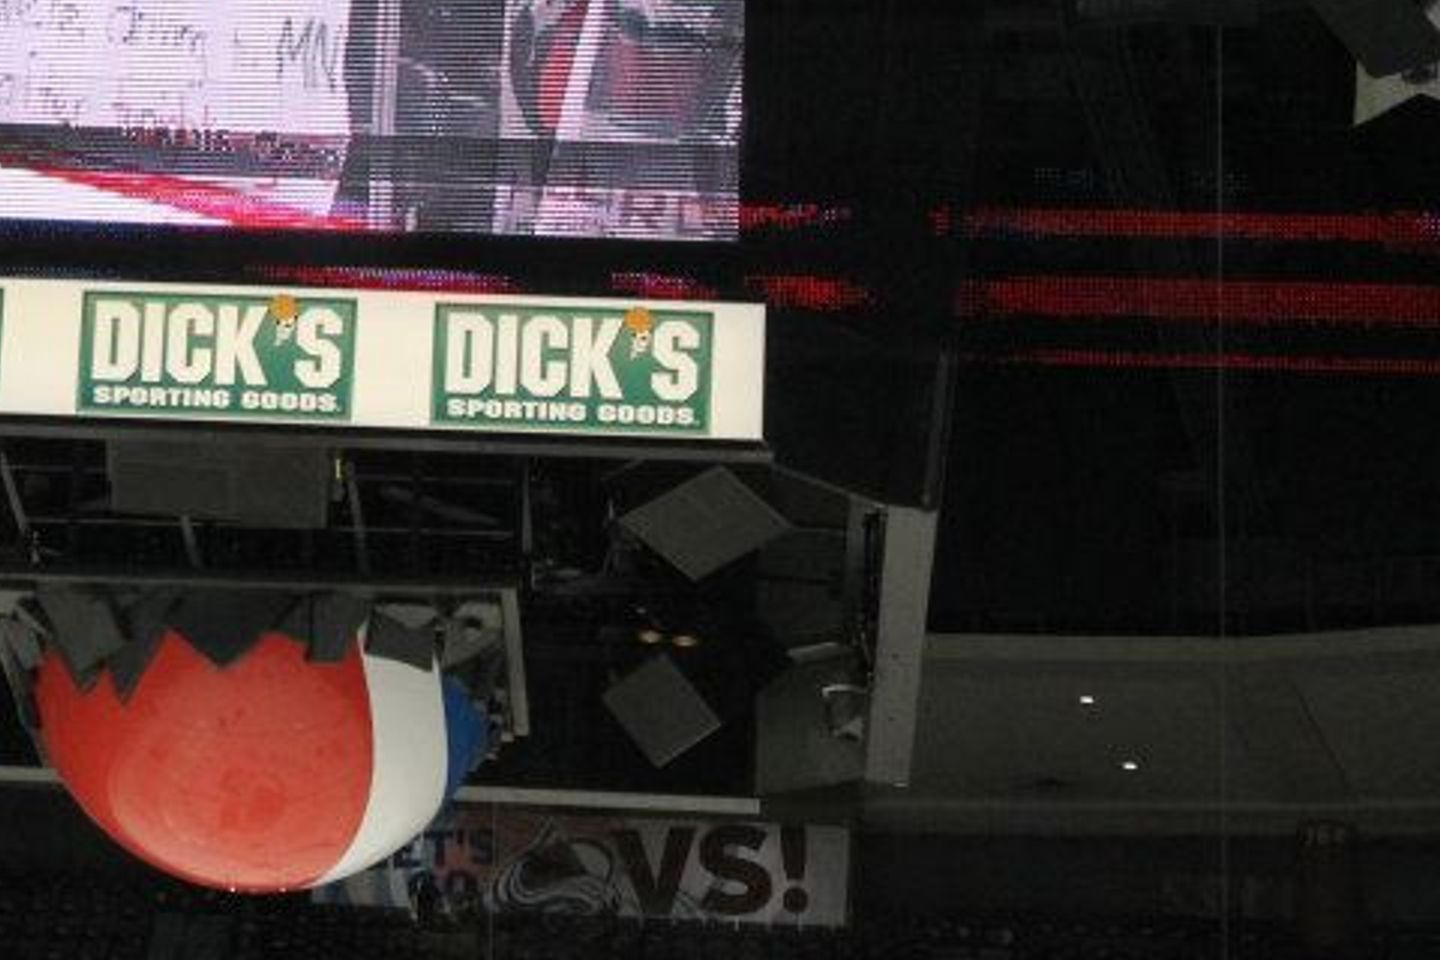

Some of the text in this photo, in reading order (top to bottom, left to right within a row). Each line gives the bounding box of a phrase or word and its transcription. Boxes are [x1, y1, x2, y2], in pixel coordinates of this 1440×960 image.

[90, 296, 344, 388] DICK'S
[445, 310, 700, 402] DICK'S
[93, 385, 338, 413] SPORTING GOODS
[446, 397, 695, 426] SPORTING GOODS
